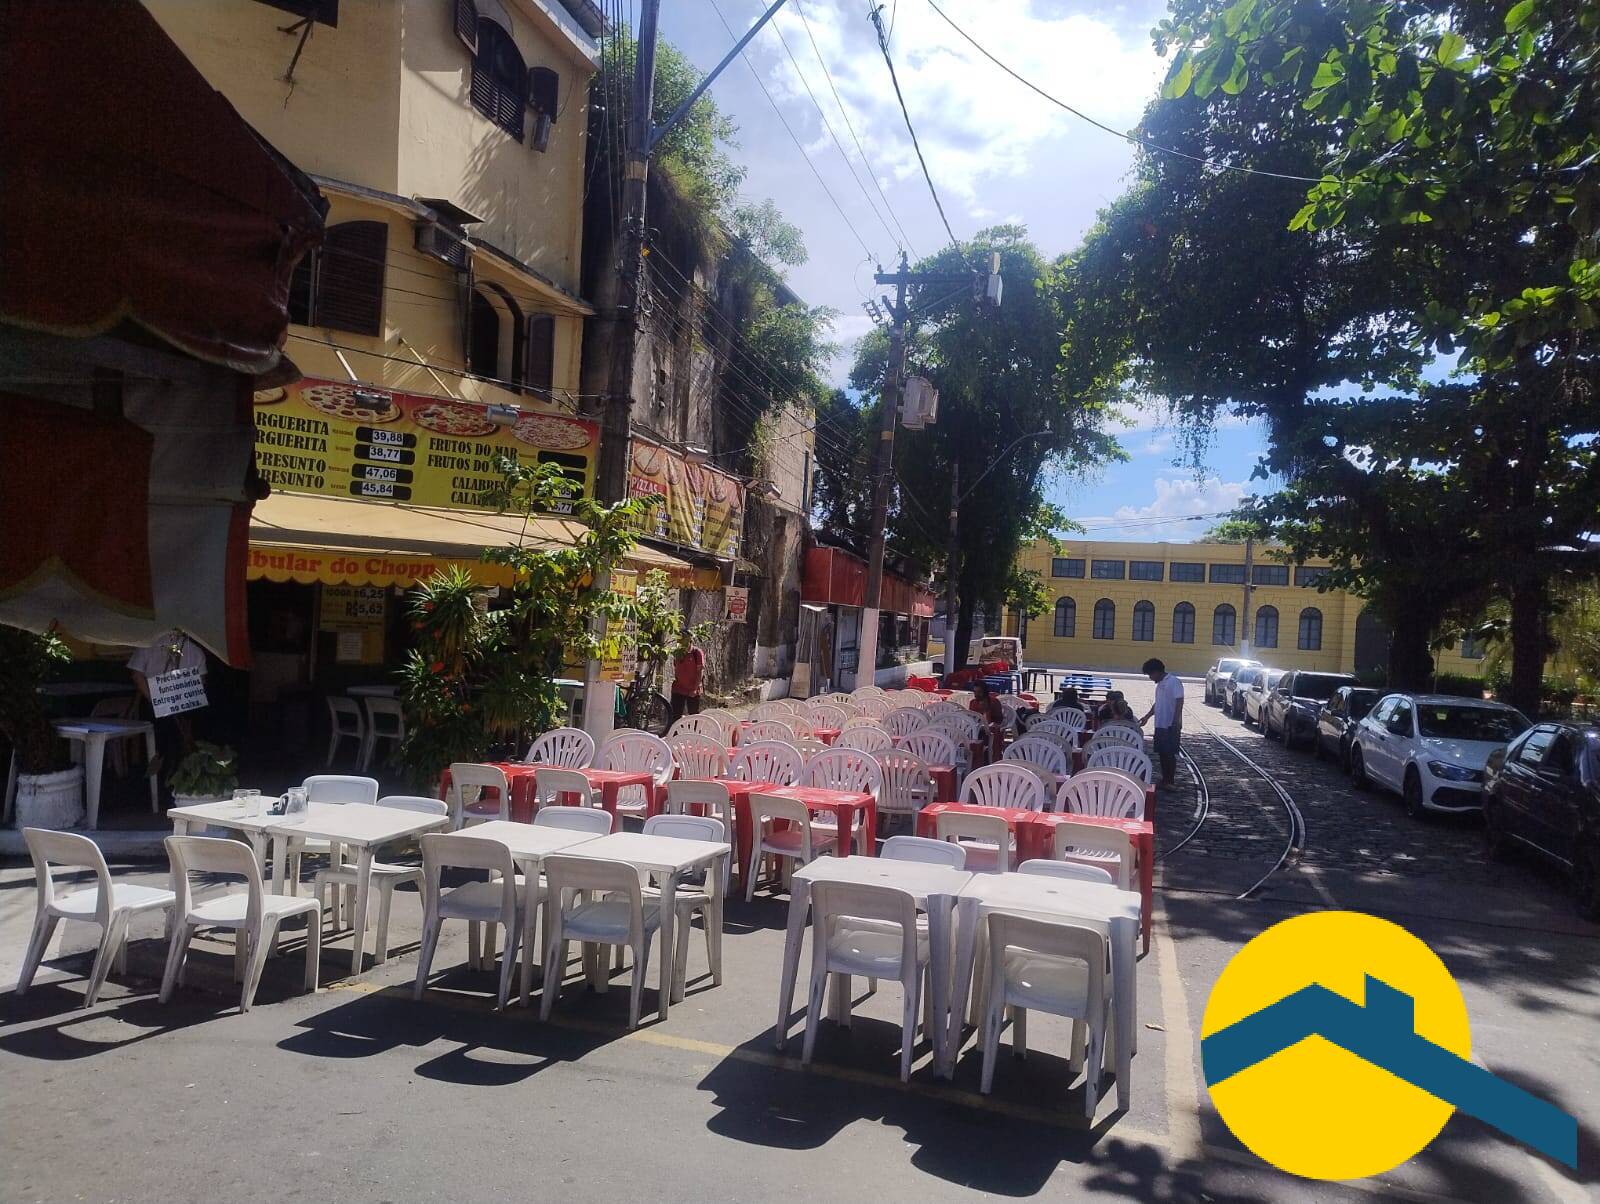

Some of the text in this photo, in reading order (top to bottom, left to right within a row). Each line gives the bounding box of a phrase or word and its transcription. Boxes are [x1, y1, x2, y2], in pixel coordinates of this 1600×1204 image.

[373, 431, 403, 443] 39,88
[370, 446, 400, 459] 38,77
[429, 437, 472, 455] FRUTOS
[474, 443, 491, 456] DO
[427, 454, 470, 471] FRUTOS
[473, 460, 490, 473] DO
[260, 468, 325, 489] RESUNTO
[366, 467, 396, 479] 47,06
[362, 483, 393, 495] 45,84
[631, 476, 658, 493] PIZZAS
[330, 557, 359, 575] do
[365, 558, 436, 578] Chopp
[153, 694, 182, 706] Entregar
